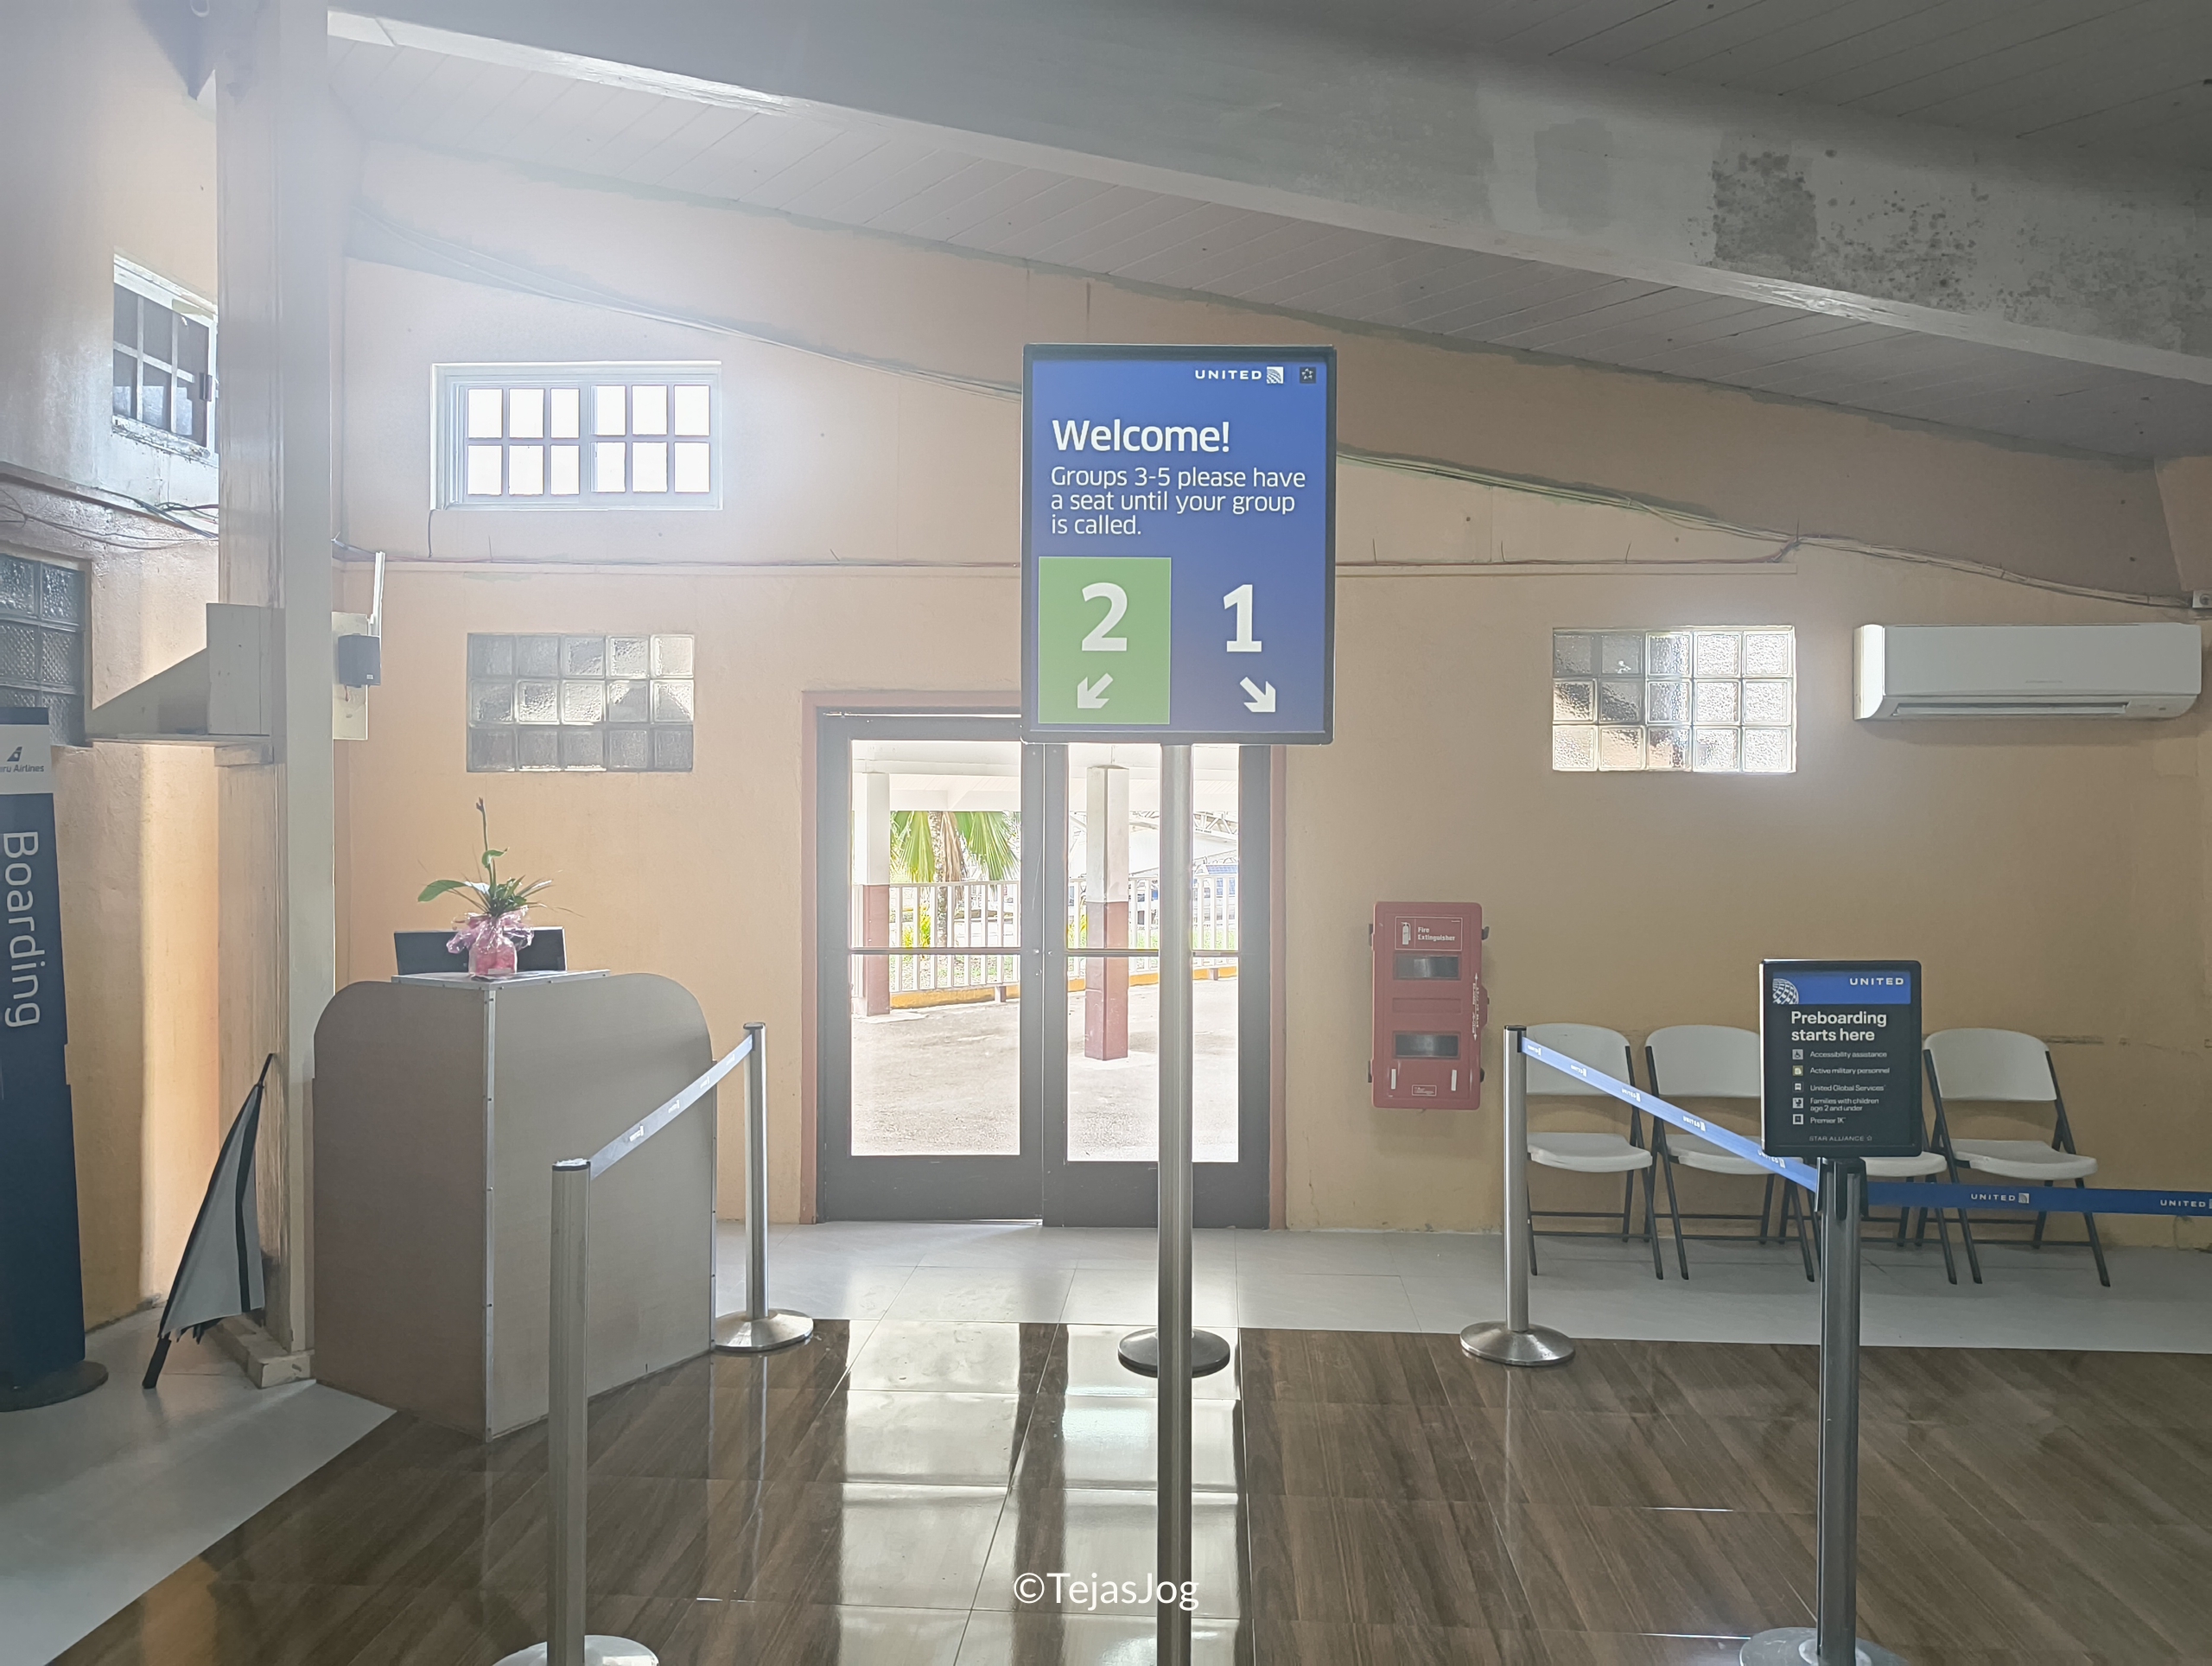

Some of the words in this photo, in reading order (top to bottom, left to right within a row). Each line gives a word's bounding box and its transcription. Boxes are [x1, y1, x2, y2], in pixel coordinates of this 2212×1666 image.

[1195, 369, 1262, 380] UNITED
[1052, 418, 1230, 454] Welcome!
[1051, 466, 1128, 490] Groups
[1135, 467, 1171, 486] 3-5
[1178, 467, 1246, 490] please
[1253, 467, 1306, 487] have
[1051, 495, 1063, 510] a
[1070, 492, 1115, 511] seat
[1122, 491, 1168, 511] until
[1175, 494, 1226, 514] your
[1232, 495, 1295, 515] group
[1051, 515, 1068, 534] is
[1074, 515, 1141, 535] called.
[1081, 582, 1128, 652] 2
[1223, 584, 1262, 652] 1
[3, 831, 46, 1027] Boarding
[1849, 977, 1904, 986] UNITED
[1791, 1011, 1887, 1027] Preboarding
[1791, 1029, 1837, 1041] starts
[1840, 1028, 1875, 1041] here
[1970, 1193, 2016, 1202] UNITED
[2160, 1199, 2206, 1208] UNITED
